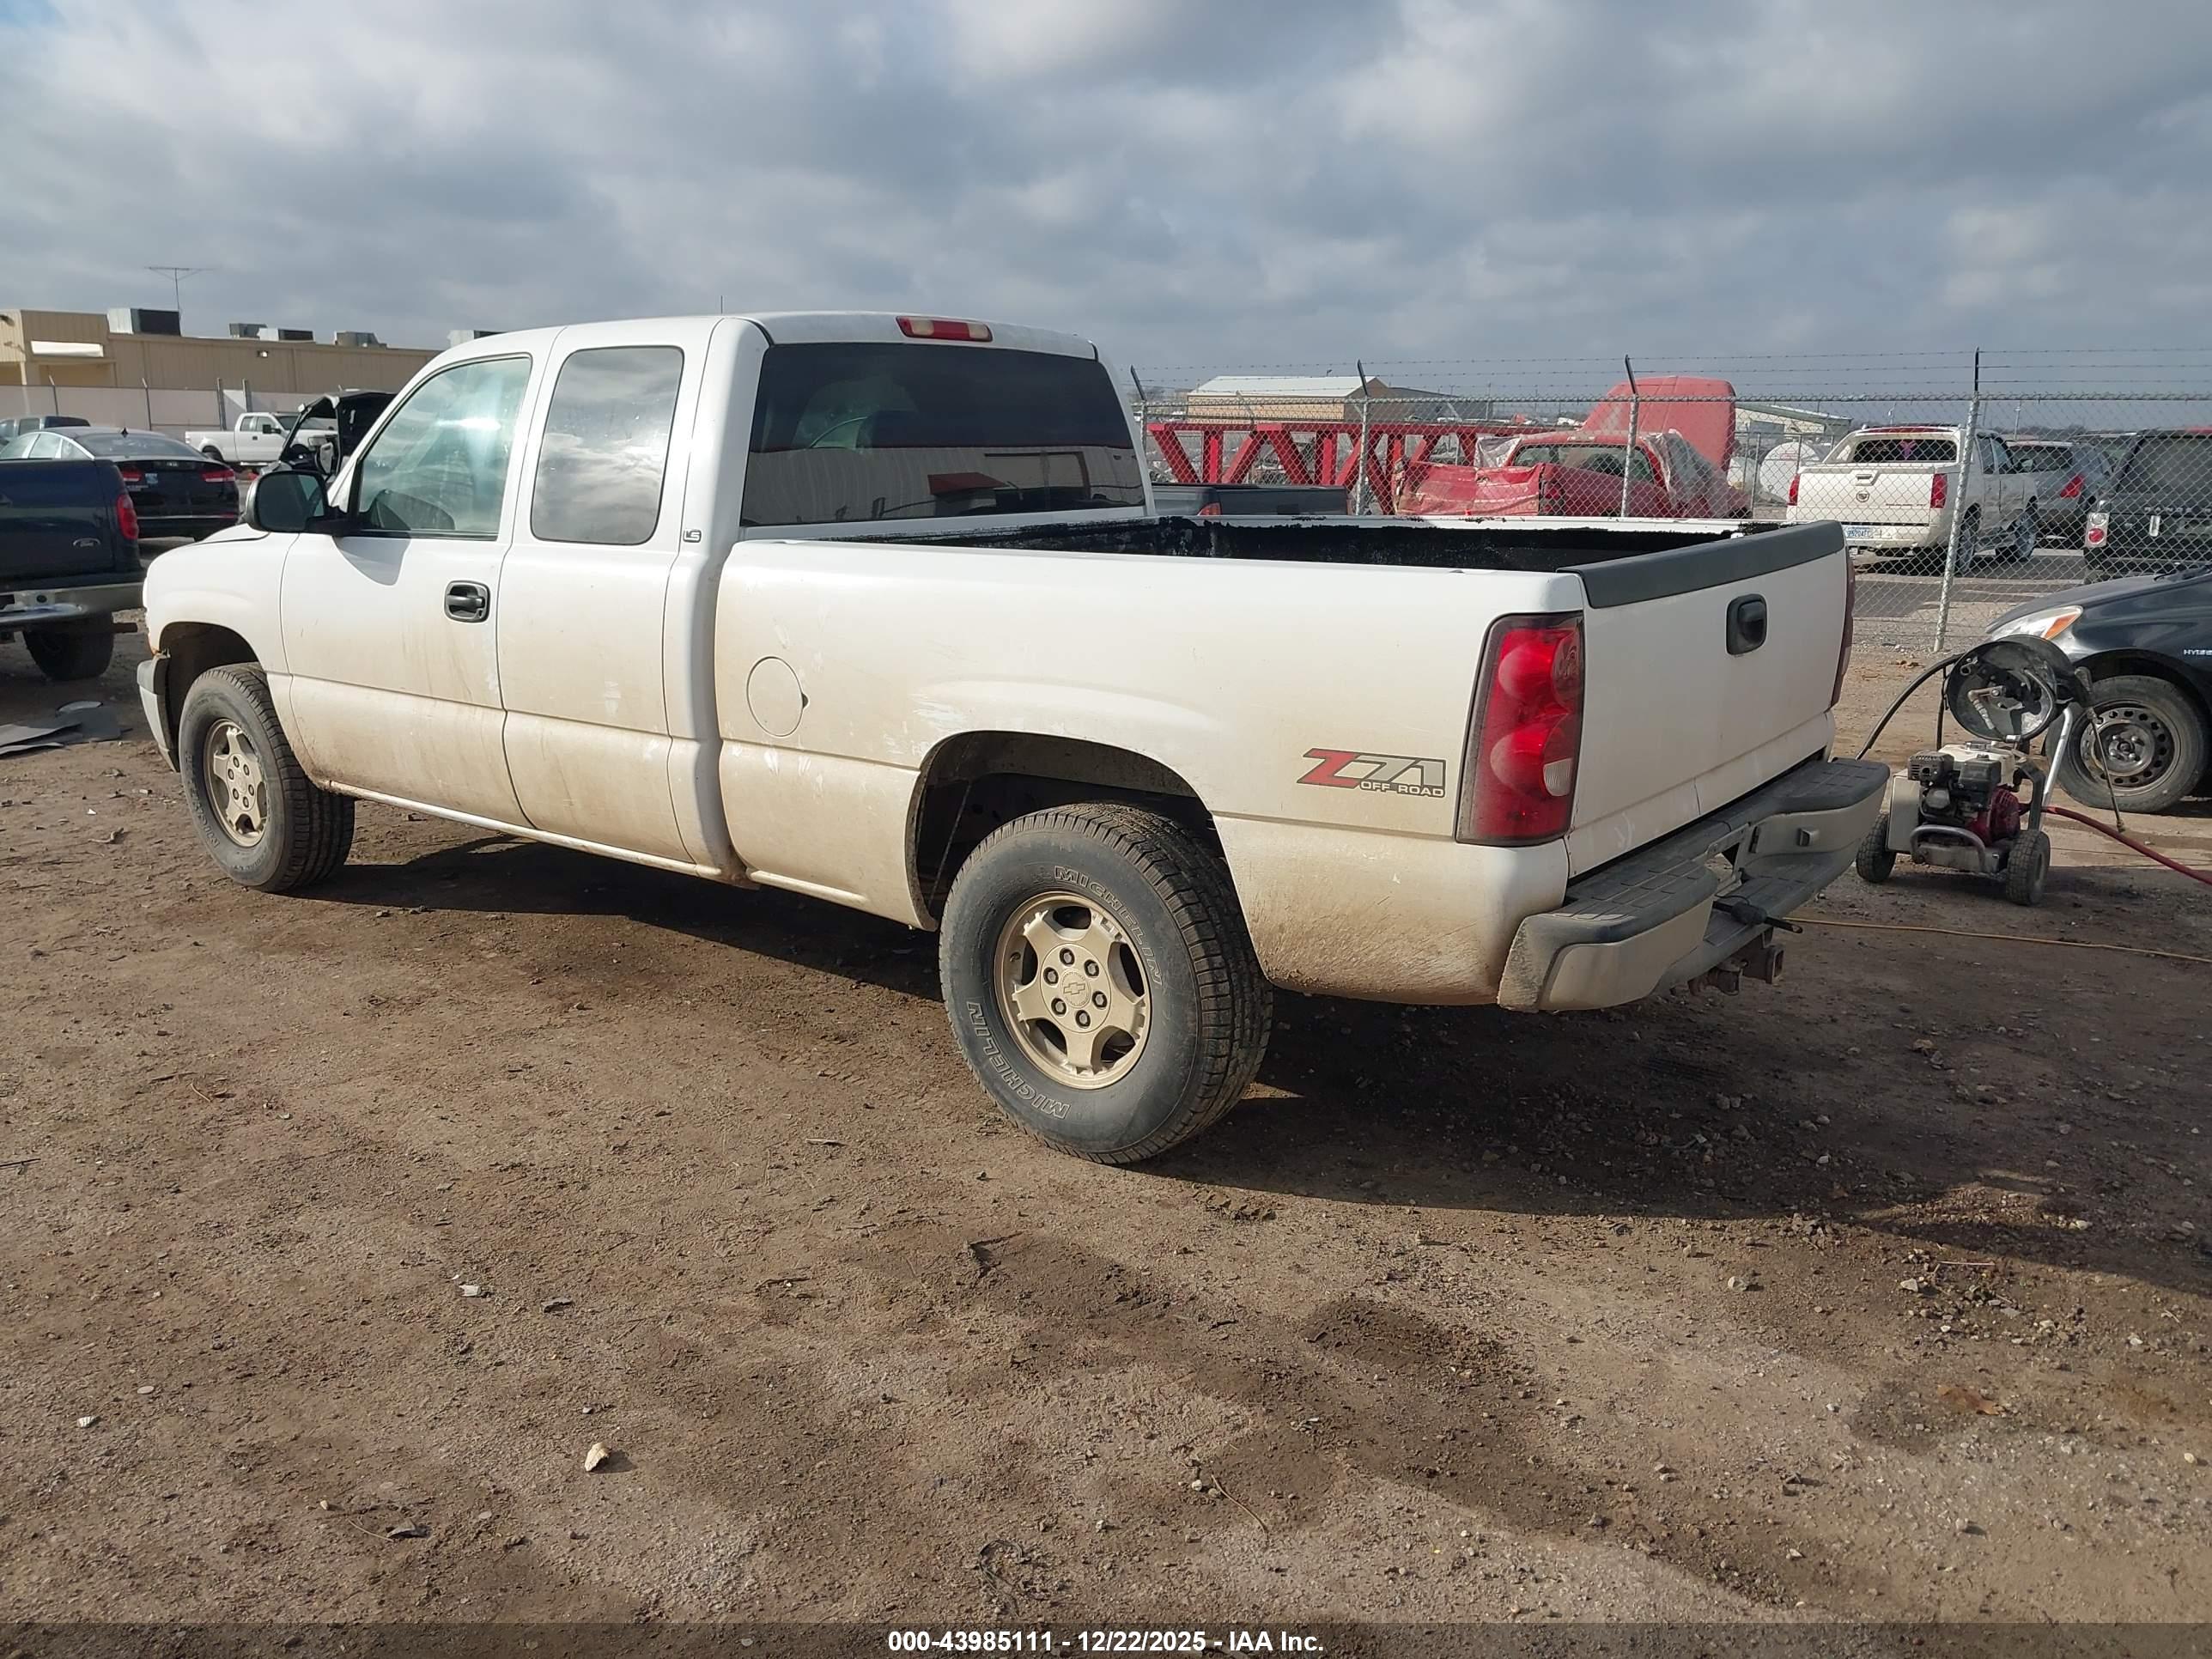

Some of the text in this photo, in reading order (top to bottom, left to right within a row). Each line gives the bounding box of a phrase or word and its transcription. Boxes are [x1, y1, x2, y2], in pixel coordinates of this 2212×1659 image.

[1296, 748, 1447, 789] Z71
[1360, 780, 1445, 797] OFF ROAD
[1054, 866, 1163, 986] MICHELIN
[967, 1001, 1072, 1119] MICHELIN
